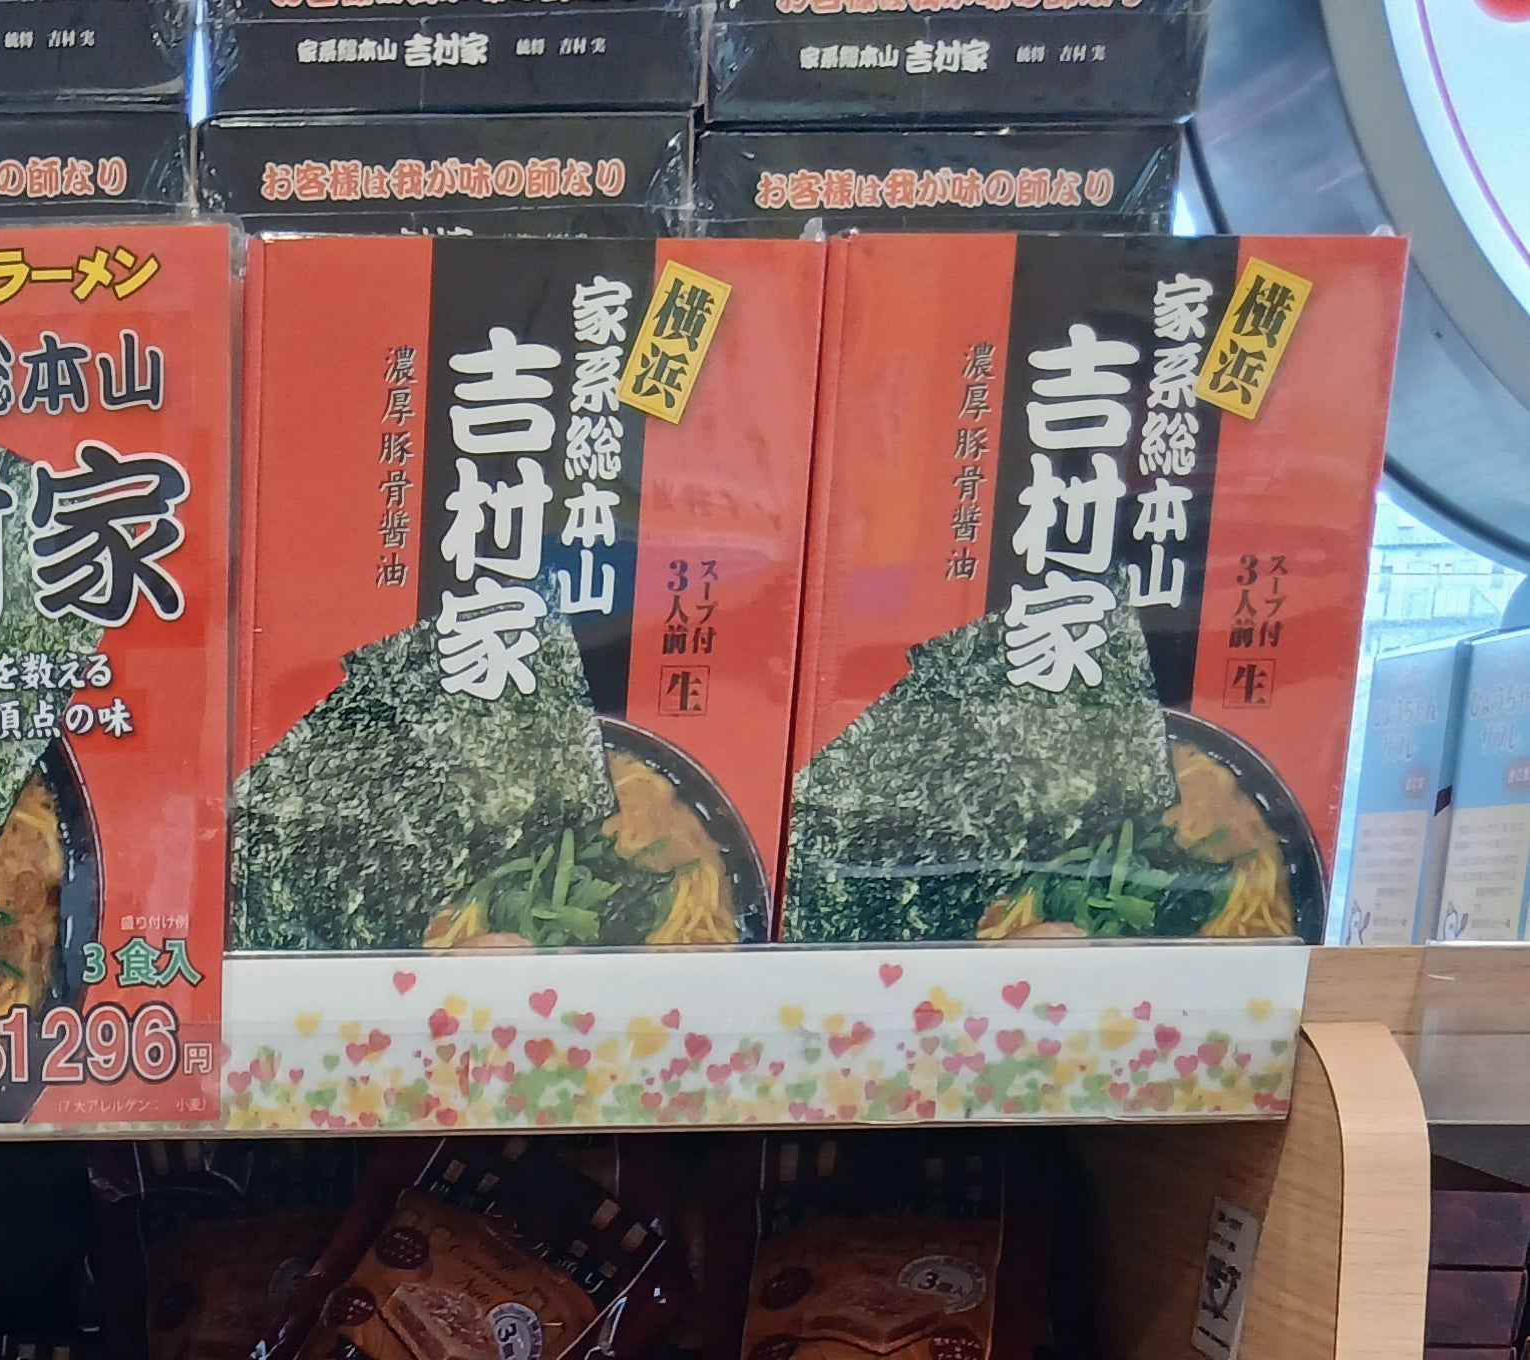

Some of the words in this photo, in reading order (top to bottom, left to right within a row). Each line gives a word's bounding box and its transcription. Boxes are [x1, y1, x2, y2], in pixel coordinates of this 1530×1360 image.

[404, 33, 489, 67] 吉村家
[905, 40, 991, 74] 吉村家
[261, 156, 626, 201] お客様は我が味の師なり
[756, 167, 1114, 210] お客様は我が味の師なり
[635, 276, 716, 410] 横浜
[1217, 274, 1297, 406] 横浜
[559, 275, 634, 618] 家系総本山
[1127, 272, 1215, 611] 家系総本山
[436, 327, 562, 700] 吉村家
[1005, 323, 1140, 694] 吉村家
[661, 559, 689, 656] 3人前
[691, 558, 719, 656] スープ付
[1227, 553, 1259, 650] 3人前
[1257, 553, 1289, 650] スープ付
[663, 667, 703, 714] 生
[1231, 664, 1267, 706] 生
